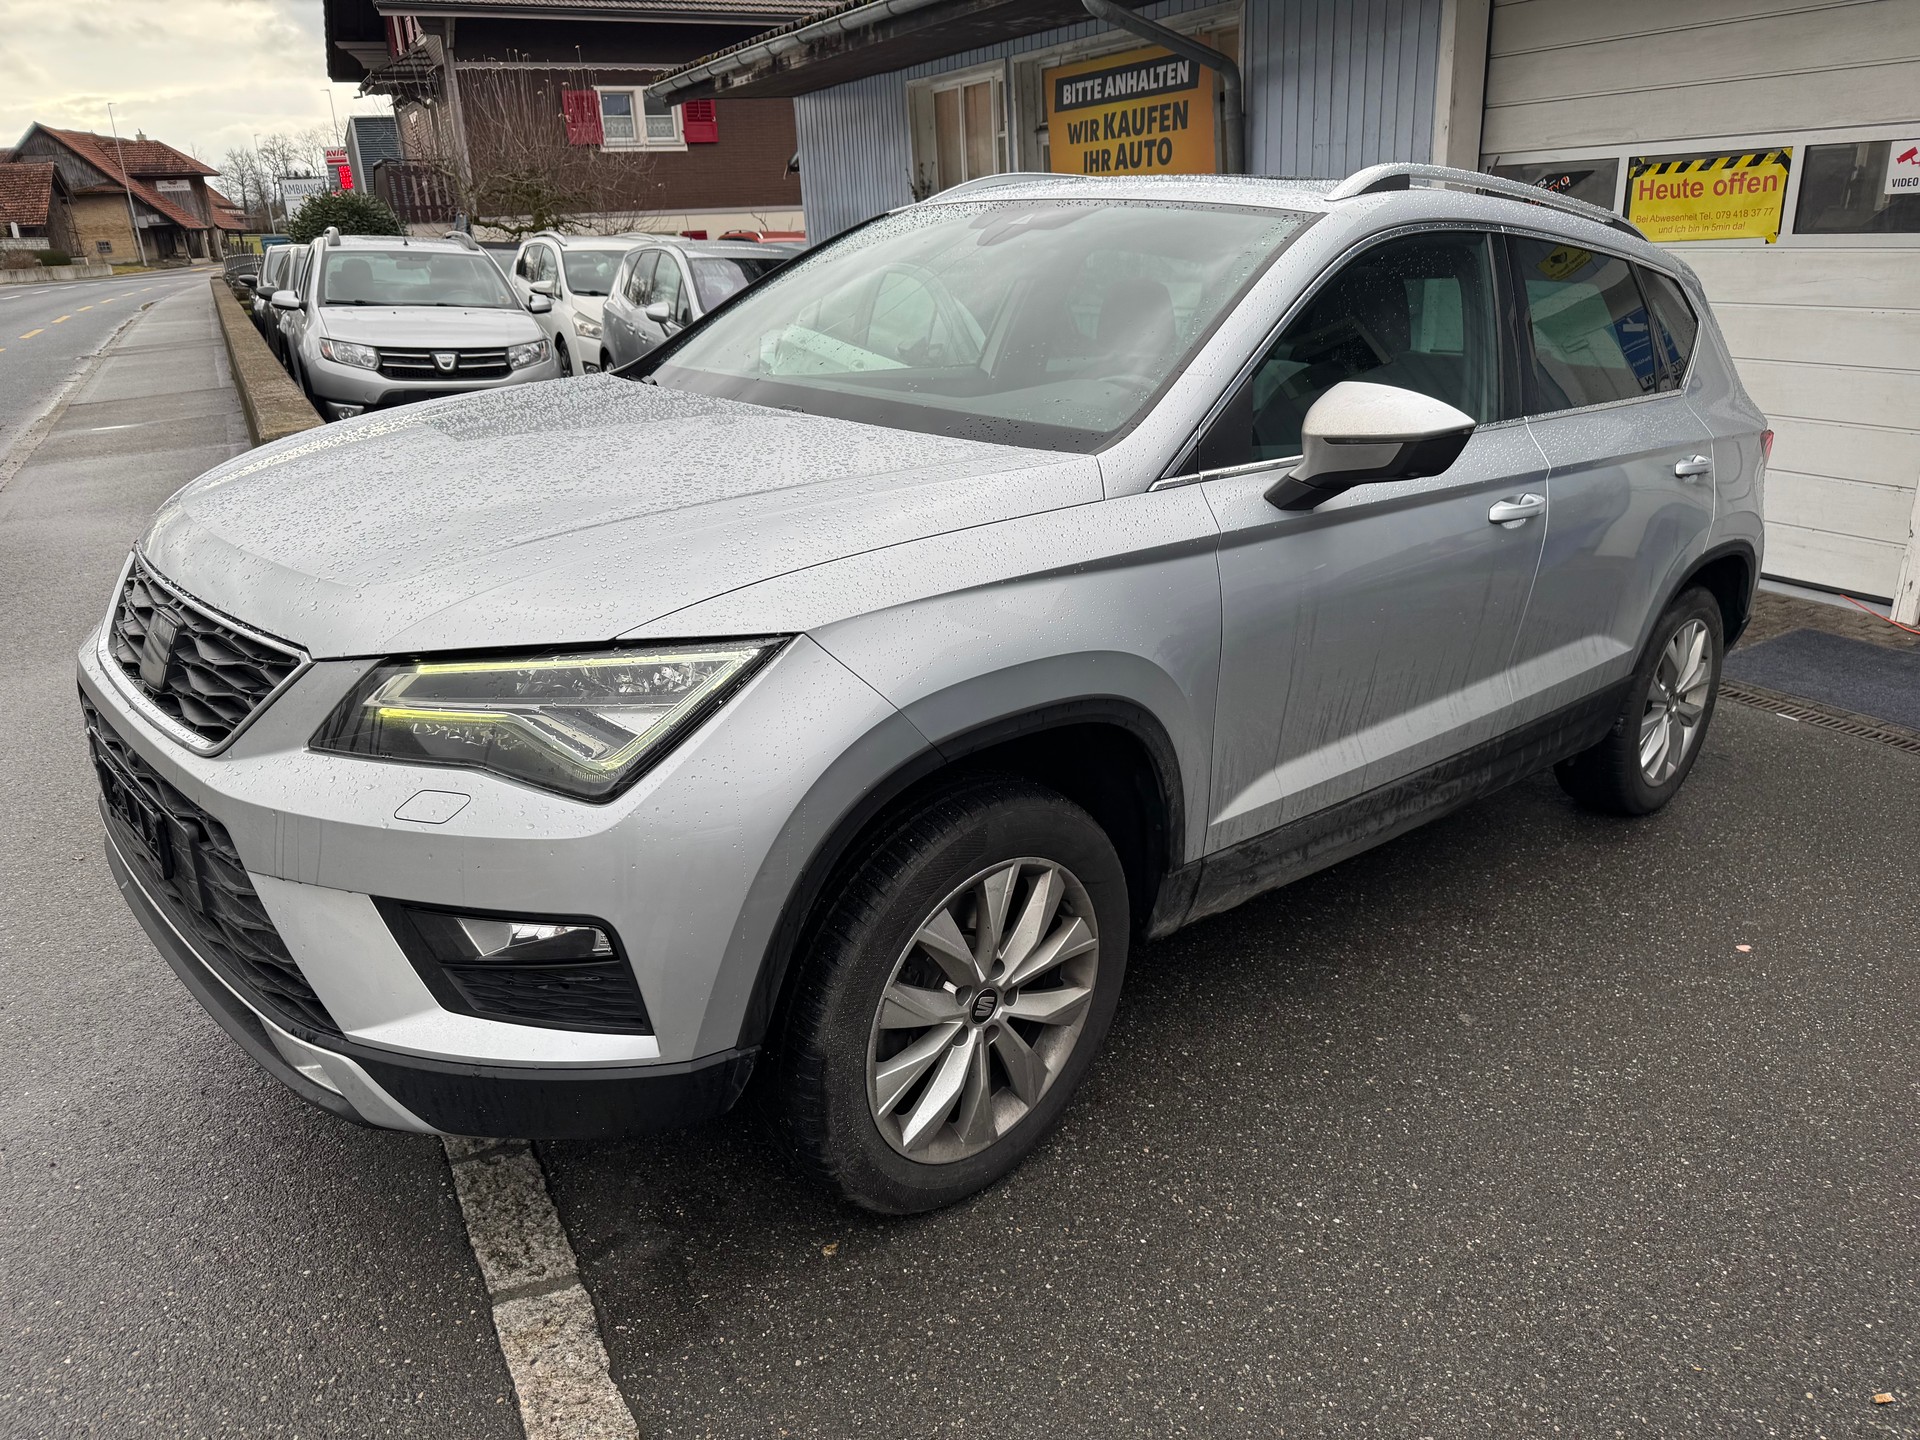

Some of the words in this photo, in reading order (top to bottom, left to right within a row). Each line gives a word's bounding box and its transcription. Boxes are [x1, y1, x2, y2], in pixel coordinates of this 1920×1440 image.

[1062, 77, 1102, 105] BITTE
[1104, 60, 1190, 98] ANHALTEN
[1067, 118, 1100, 145] WIR
[1103, 99, 1189, 141] KAUFEN
[326, 149, 346, 157] AVIA
[1083, 149, 1111, 174] IHR
[1114, 137, 1173, 171] AUTO
[1638, 178, 1704, 201] Heute
[1712, 172, 1778, 196] offen
[1892, 177, 1919, 187] VIDEO
[1635, 214, 1649, 224] Bei
[1649, 212, 1698, 223] Abwesenheit
[1699, 211, 1713, 221] Tel.
[1715, 209, 1732, 220] 079
[1732, 208, 1749, 218] 418
[1750, 208, 1762, 217] 37
[1763, 207, 1775, 217] 77
[1658, 225, 1673, 234] und
[1674, 224, 1686, 233] ich
[1687, 223, 1700, 232] bin
[1701, 223, 1709, 231] in
[1711, 221, 1731, 231] 5min
[1732, 221, 1746, 230] da!
